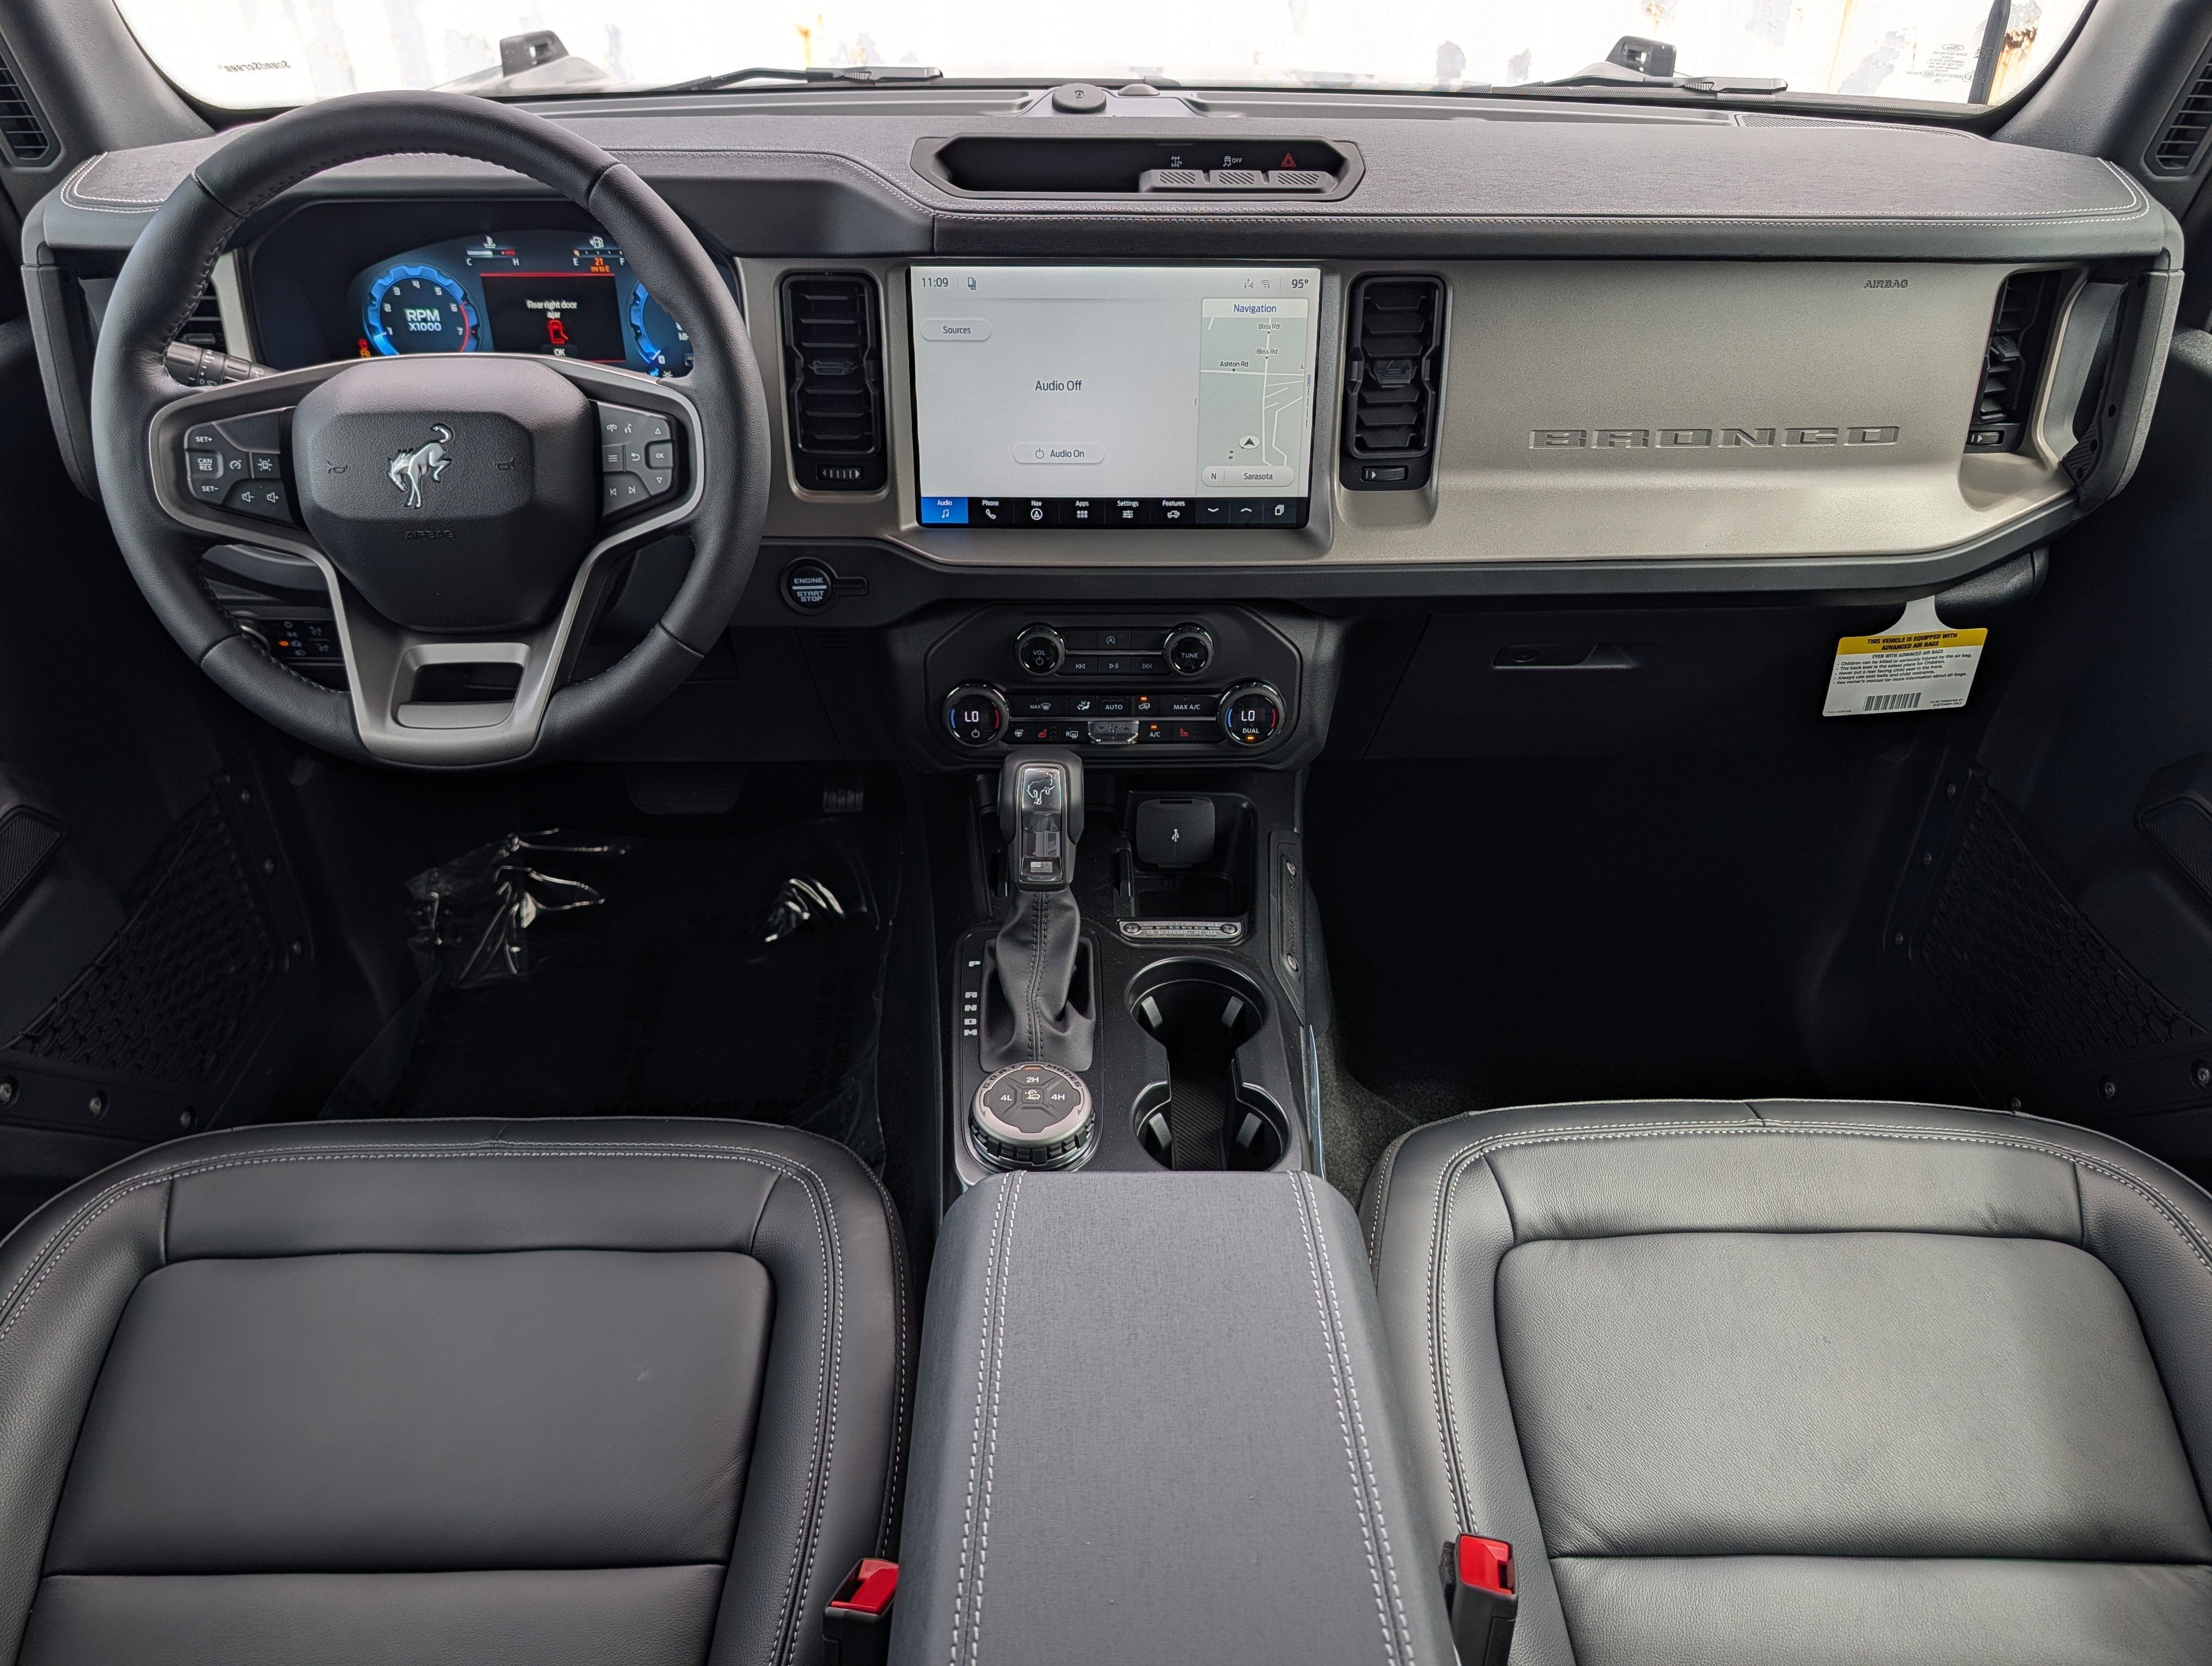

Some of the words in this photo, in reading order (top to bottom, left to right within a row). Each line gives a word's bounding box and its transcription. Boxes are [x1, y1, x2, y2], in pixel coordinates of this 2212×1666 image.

[466, 258, 473, 266] C
[512, 258, 519, 266] H
[573, 258, 579, 266] E
[594, 257, 603, 266] 21
[619, 258, 625, 266] F
[411, 279, 420, 289] 4
[922, 277, 948, 287] 11:09
[1863, 279, 1908, 289] AIRBAG
[393, 286, 401, 296] 3
[434, 286, 442, 296] 5
[383, 303, 392, 312] 2
[449, 303, 458, 312] 6
[526, 299, 544, 309] Rear
[544, 299, 561, 310] right
[561, 299, 577, 309] door
[1233, 304, 1277, 314] Navigation
[405, 308, 441, 322] RPM
[546, 310, 561, 319] ajar
[387, 326, 393, 336] 1
[408, 322, 442, 331] X1000
[456, 326, 464, 336] 7
[943, 326, 971, 334] Sources
[554, 348, 565, 356] OK
[658, 355, 665, 364] 0
[1035, 380, 1064, 391] Audio
[1067, 380, 1082, 391] Off
[1528, 426, 1900, 450] BRONCO
[1050, 450, 1072, 458] Audio
[1073, 450, 1084, 458] On
[964, 711, 979, 722] LO
[1241, 710, 1255, 721] LO
[1047, 1064, 1082, 1088] MODES
